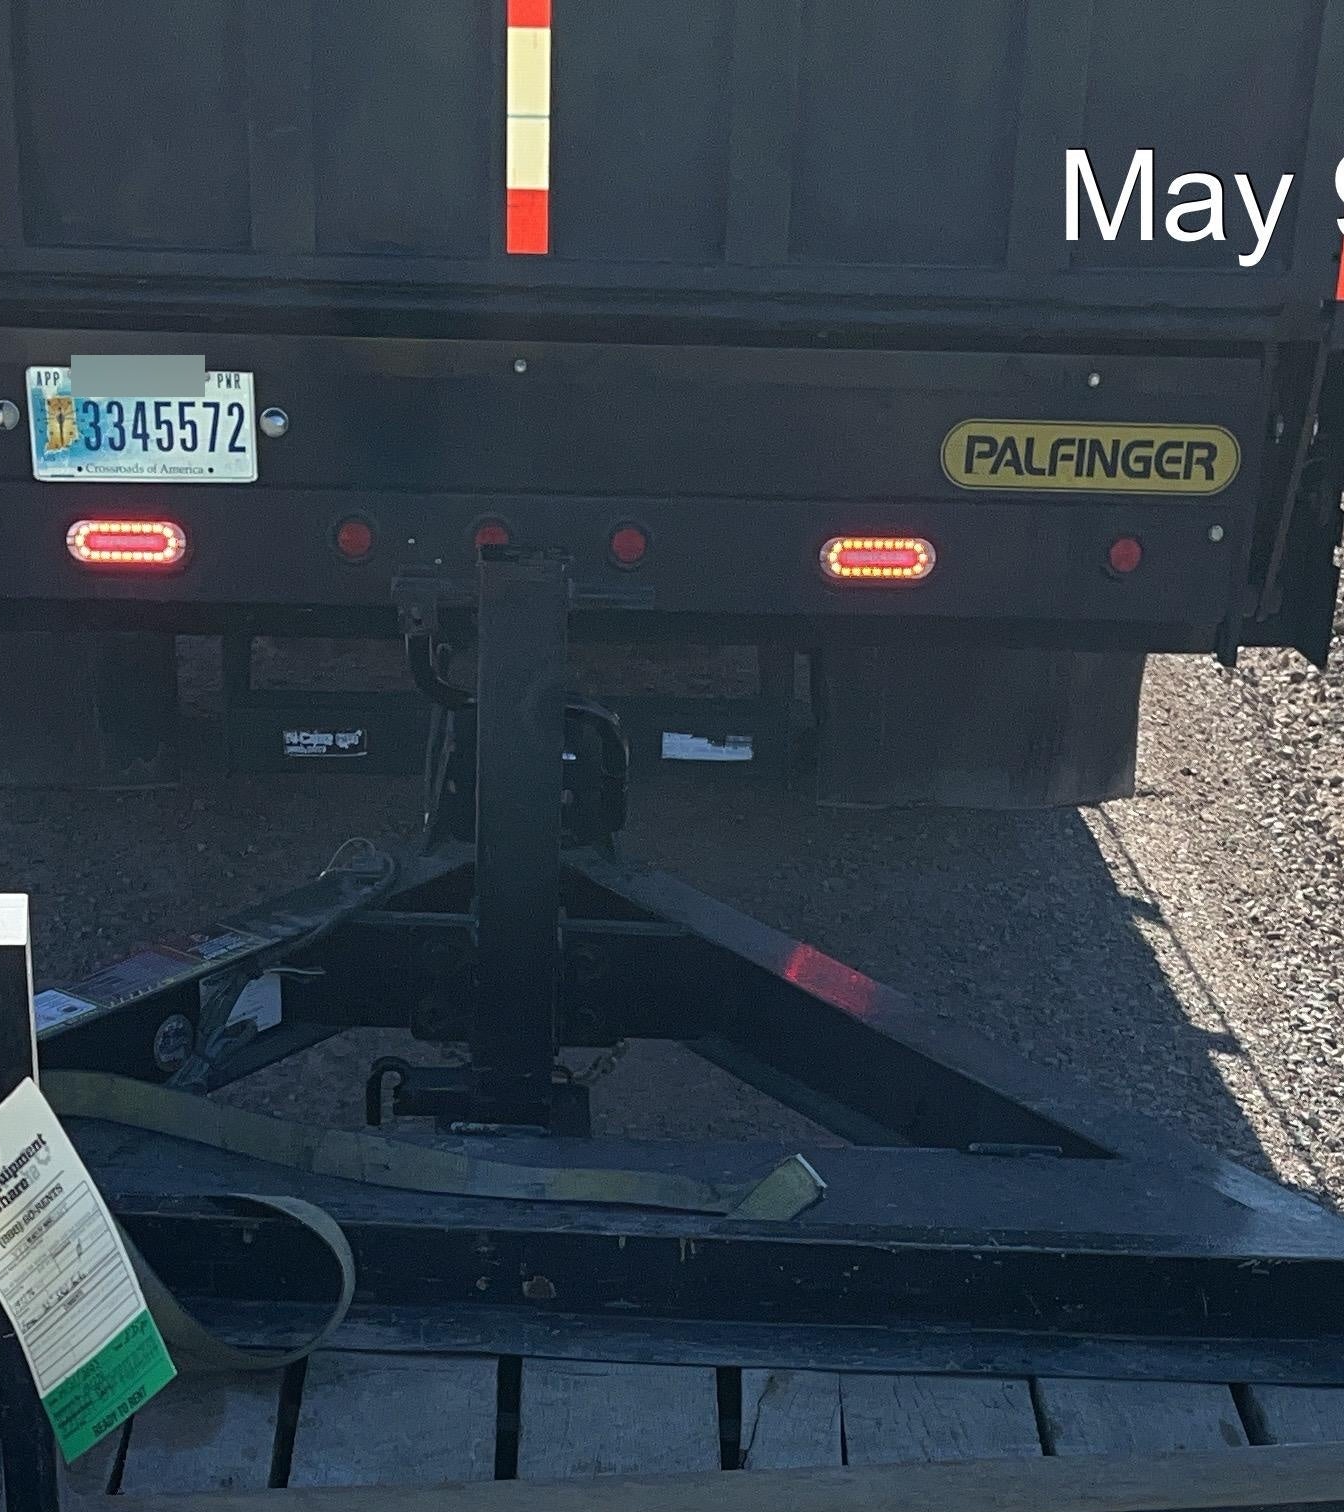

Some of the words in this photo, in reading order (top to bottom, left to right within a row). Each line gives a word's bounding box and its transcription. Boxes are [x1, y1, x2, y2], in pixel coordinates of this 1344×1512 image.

[36, 371, 61, 387] APP
[217, 373, 241, 390] PWR
[82, 400, 247, 454] 3345572
[85, 463, 145, 475] Crossroads
[147, 463, 157, 474] of
[161, 463, 204, 475] America
[963, 434, 1218, 482] PALFINGER
